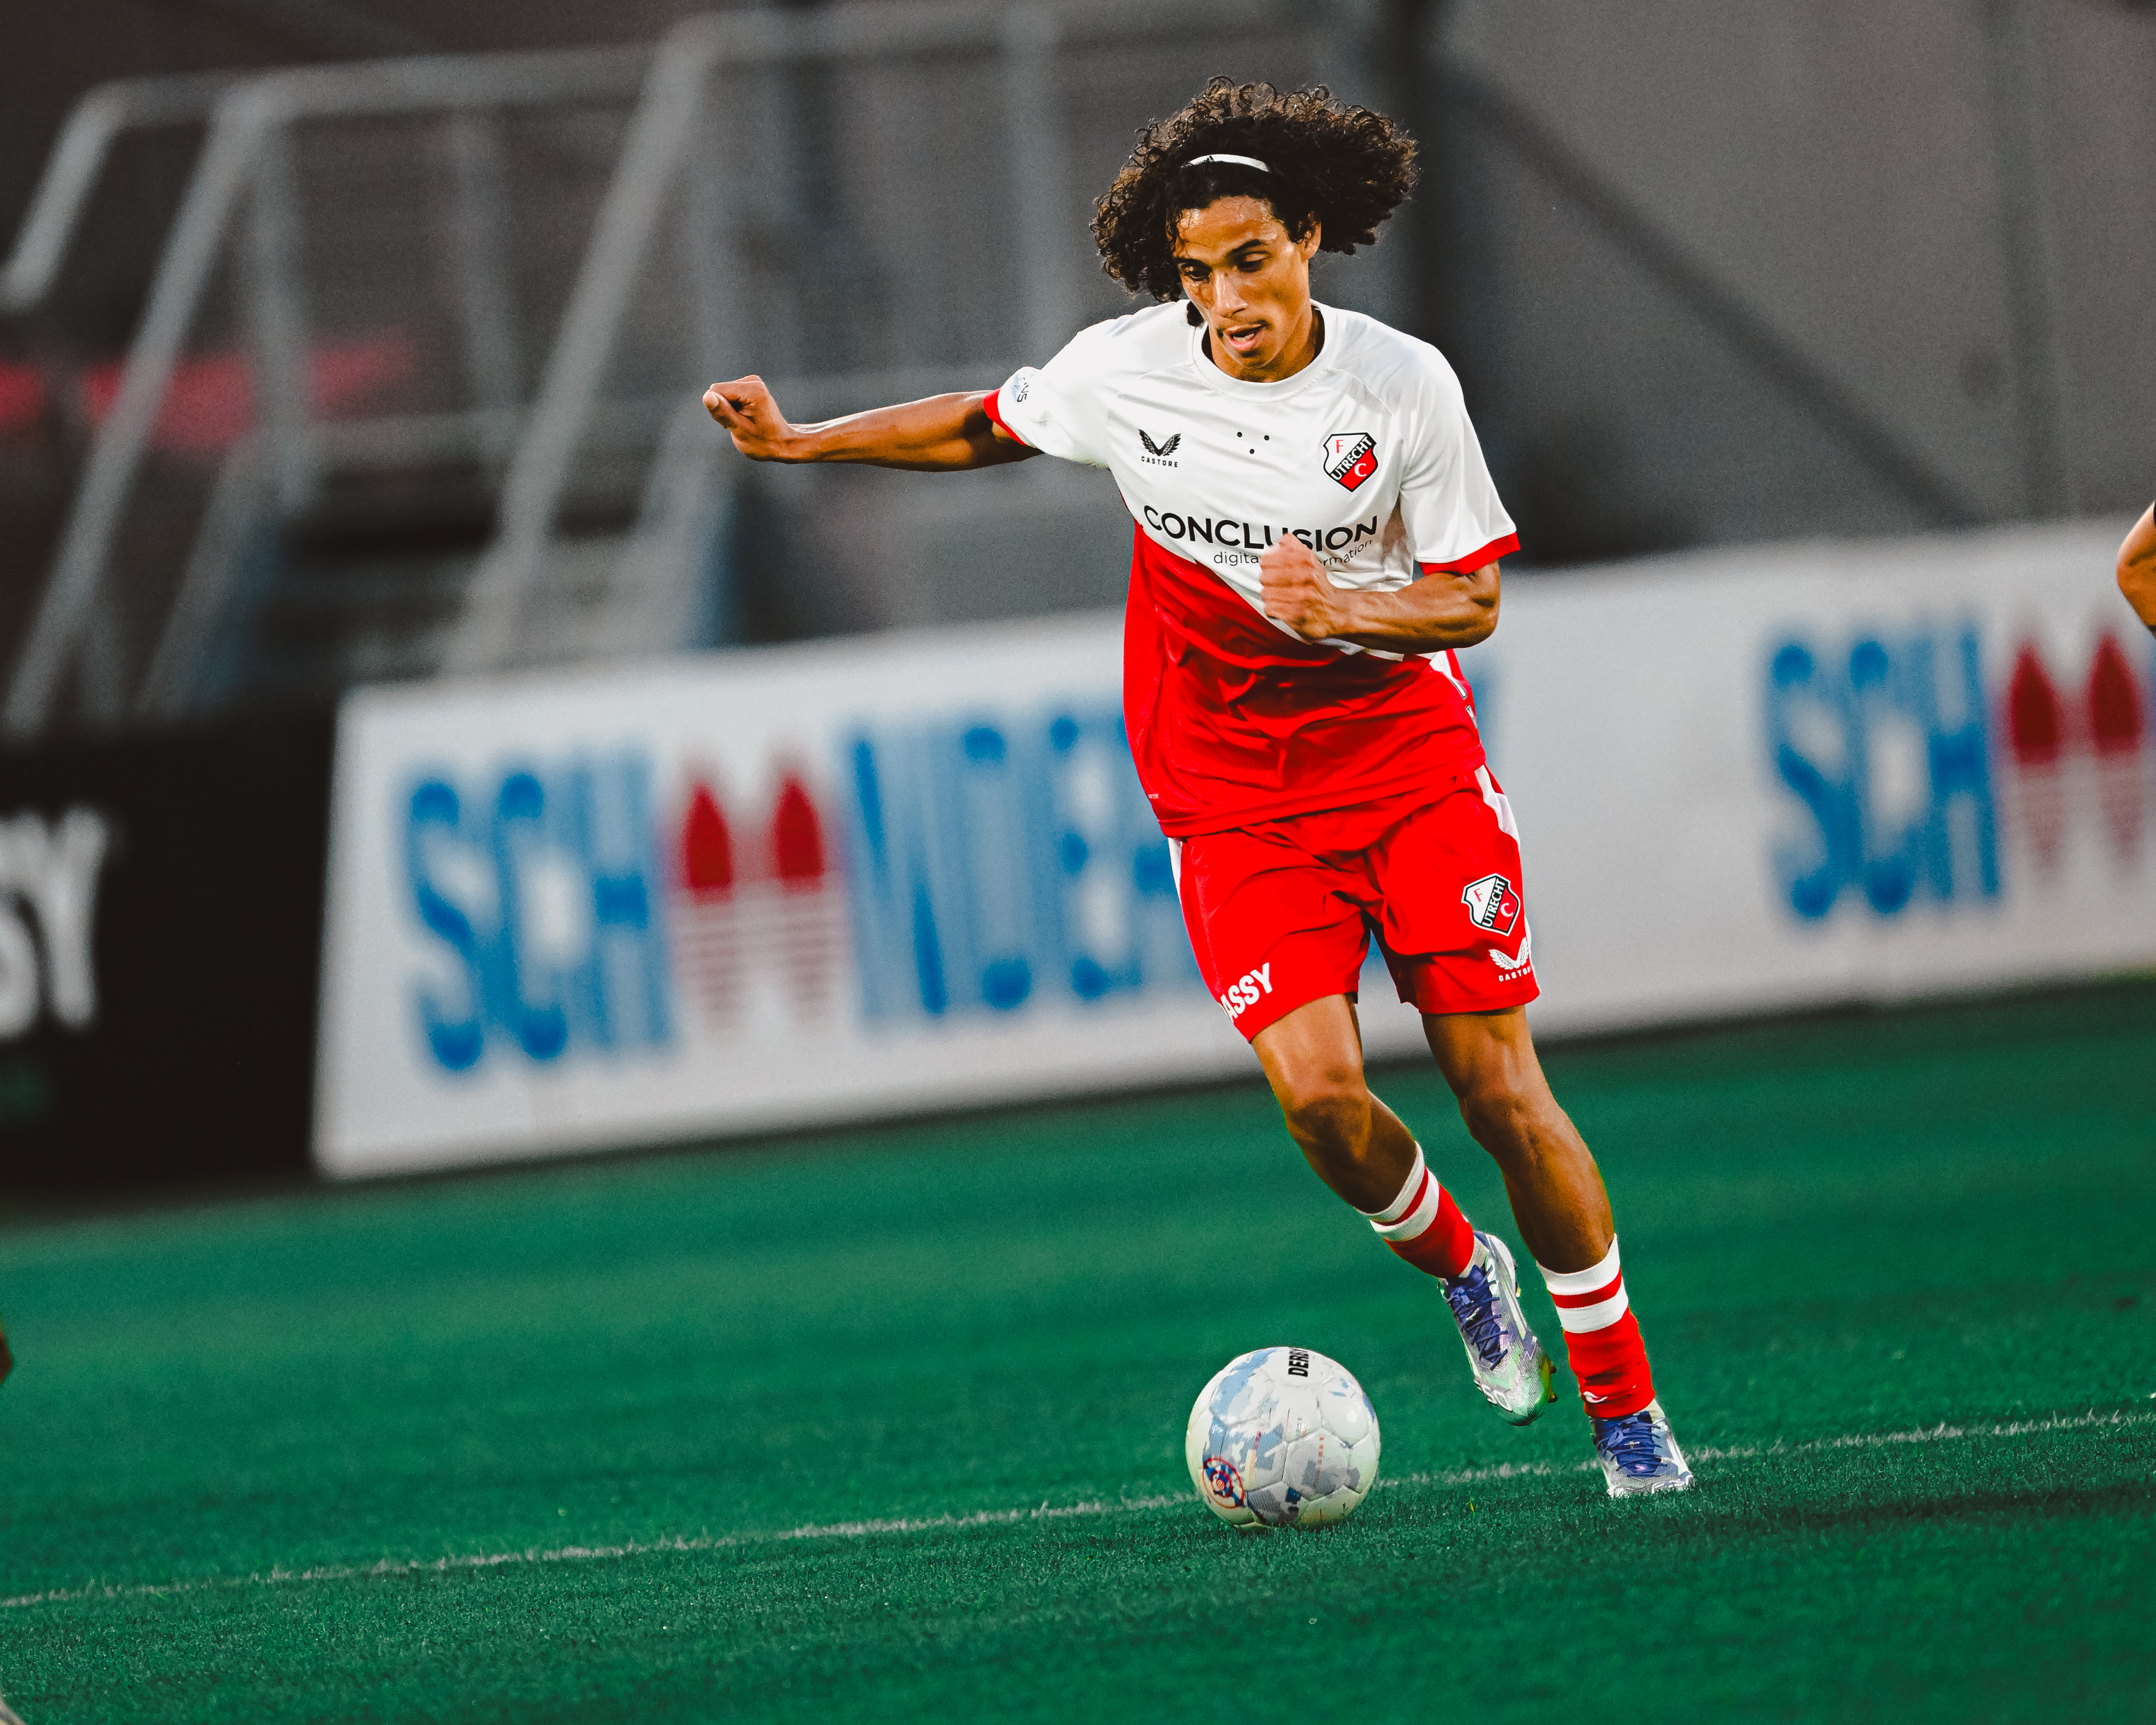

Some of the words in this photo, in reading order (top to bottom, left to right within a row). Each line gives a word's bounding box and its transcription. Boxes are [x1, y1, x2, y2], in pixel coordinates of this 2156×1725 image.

[1336, 440, 1344, 453] F
[1141, 456, 1178, 467] CASTORE
[1331, 436, 1372, 480] UTRECHT
[1354, 463, 1367, 477] C
[1214, 550, 1259, 566] digita
[1318, 539, 1372, 566] rmation
[1473, 888, 1483, 902] F
[1482, 879, 1505, 927] UTRECHT
[1500, 903, 1514, 917] C
[1219, 962, 1273, 1023] ASSY
